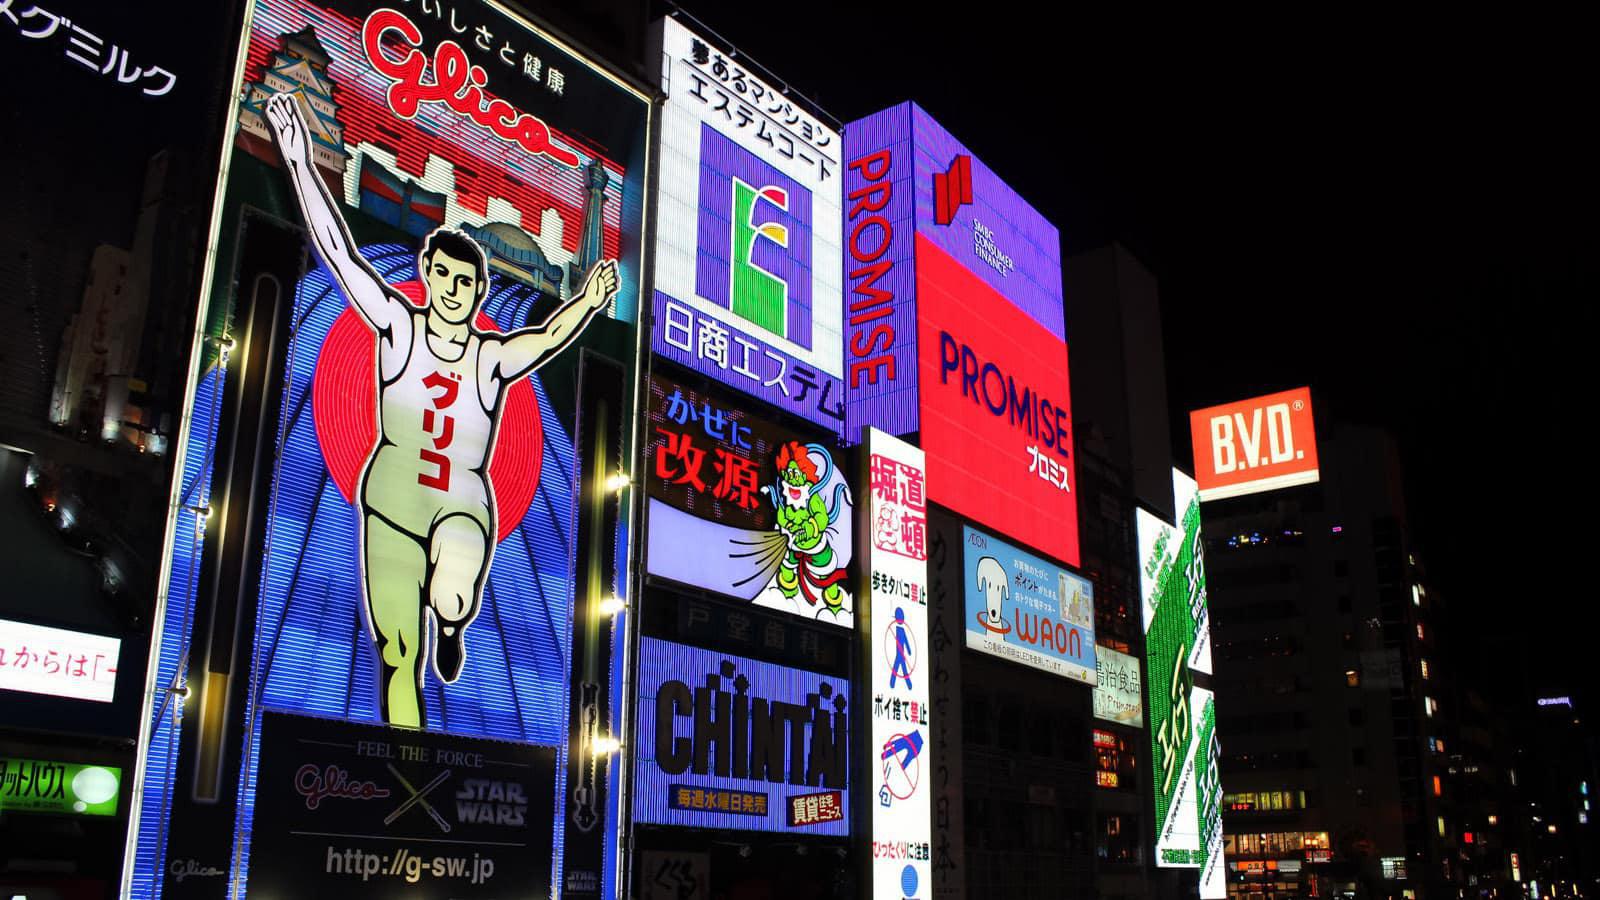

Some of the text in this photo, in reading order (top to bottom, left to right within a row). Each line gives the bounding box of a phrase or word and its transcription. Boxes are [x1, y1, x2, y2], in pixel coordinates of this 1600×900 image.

[401, 0, 567, 96] いしさと健康
[362, 8, 584, 168] Glico
[690, 36, 832, 147] 夢あるマンション
[688, 72, 832, 183] エステムコート
[973, 217, 995, 243] SMBC
[974, 230, 1014, 272] CONSUMER
[847, 148, 896, 391] PROMISE
[974, 243, 1008, 278] FINANCE
[664, 303, 846, 420] 日商エステム
[939, 331, 1070, 459] PROMISE
[418, 370, 463, 493] グリコ
[665, 389, 754, 451] かぜに
[1210, 402, 1304, 475] B.V.D.
[655, 428, 765, 512] 改源
[1026, 445, 1071, 493] プロミス
[872, 570, 927, 606] 歩きタバコ禁止
[1015, 607, 1082, 659] WAON
[0, 645, 118, 682] からは「
[874, 694, 928, 726] ポイ捨て禁止
[356, 740, 484, 769] FEEL THE FORCE
[294, 763, 391, 811] Glico
[456, 778, 528, 805] STAR
[677, 789, 768, 814] 毎週水曜日発売
[456, 802, 528, 827] WARS
[169, 858, 225, 884] Glico
[326, 846, 496, 885] http://g-sw.jp
